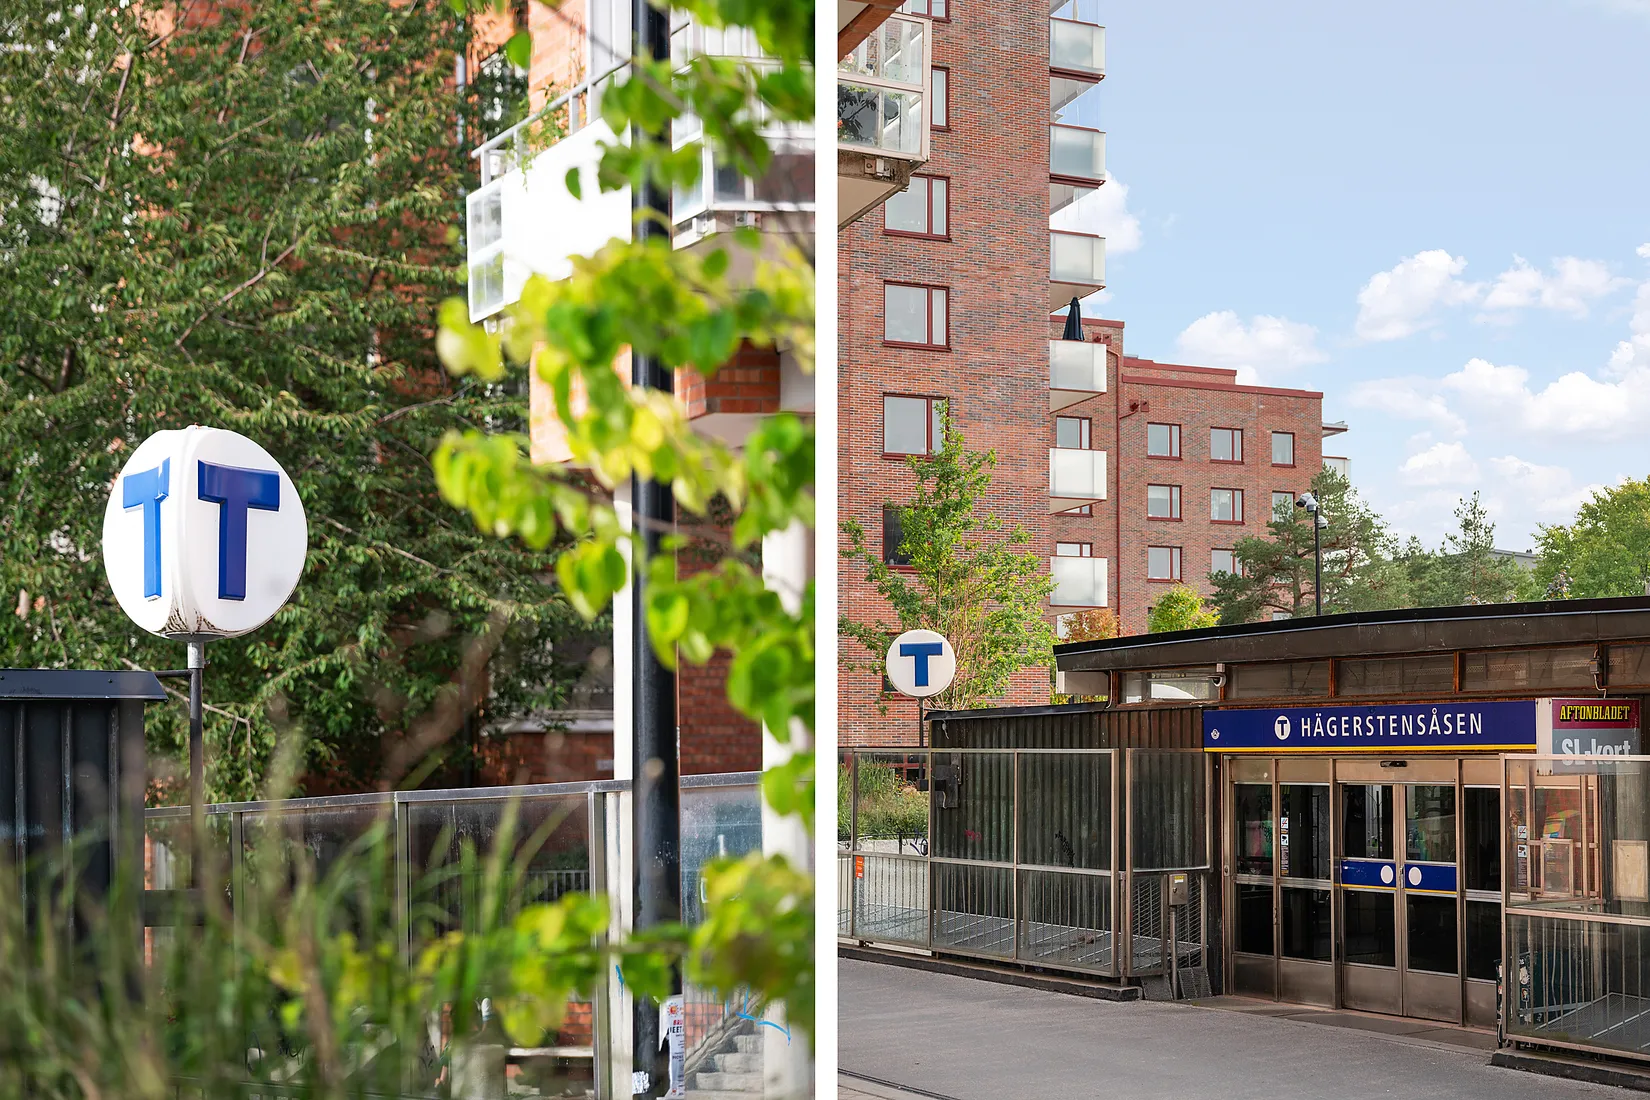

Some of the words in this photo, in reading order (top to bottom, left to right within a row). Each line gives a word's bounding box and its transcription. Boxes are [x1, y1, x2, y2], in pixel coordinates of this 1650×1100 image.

[122, 456, 171, 601] T
[197, 459, 280, 601] T
[900, 642, 942, 687] T
[1301, 707, 1482, 737] HÄGERSTENSÅSEN
[1560, 705, 1631, 721] AFTONBLADET
